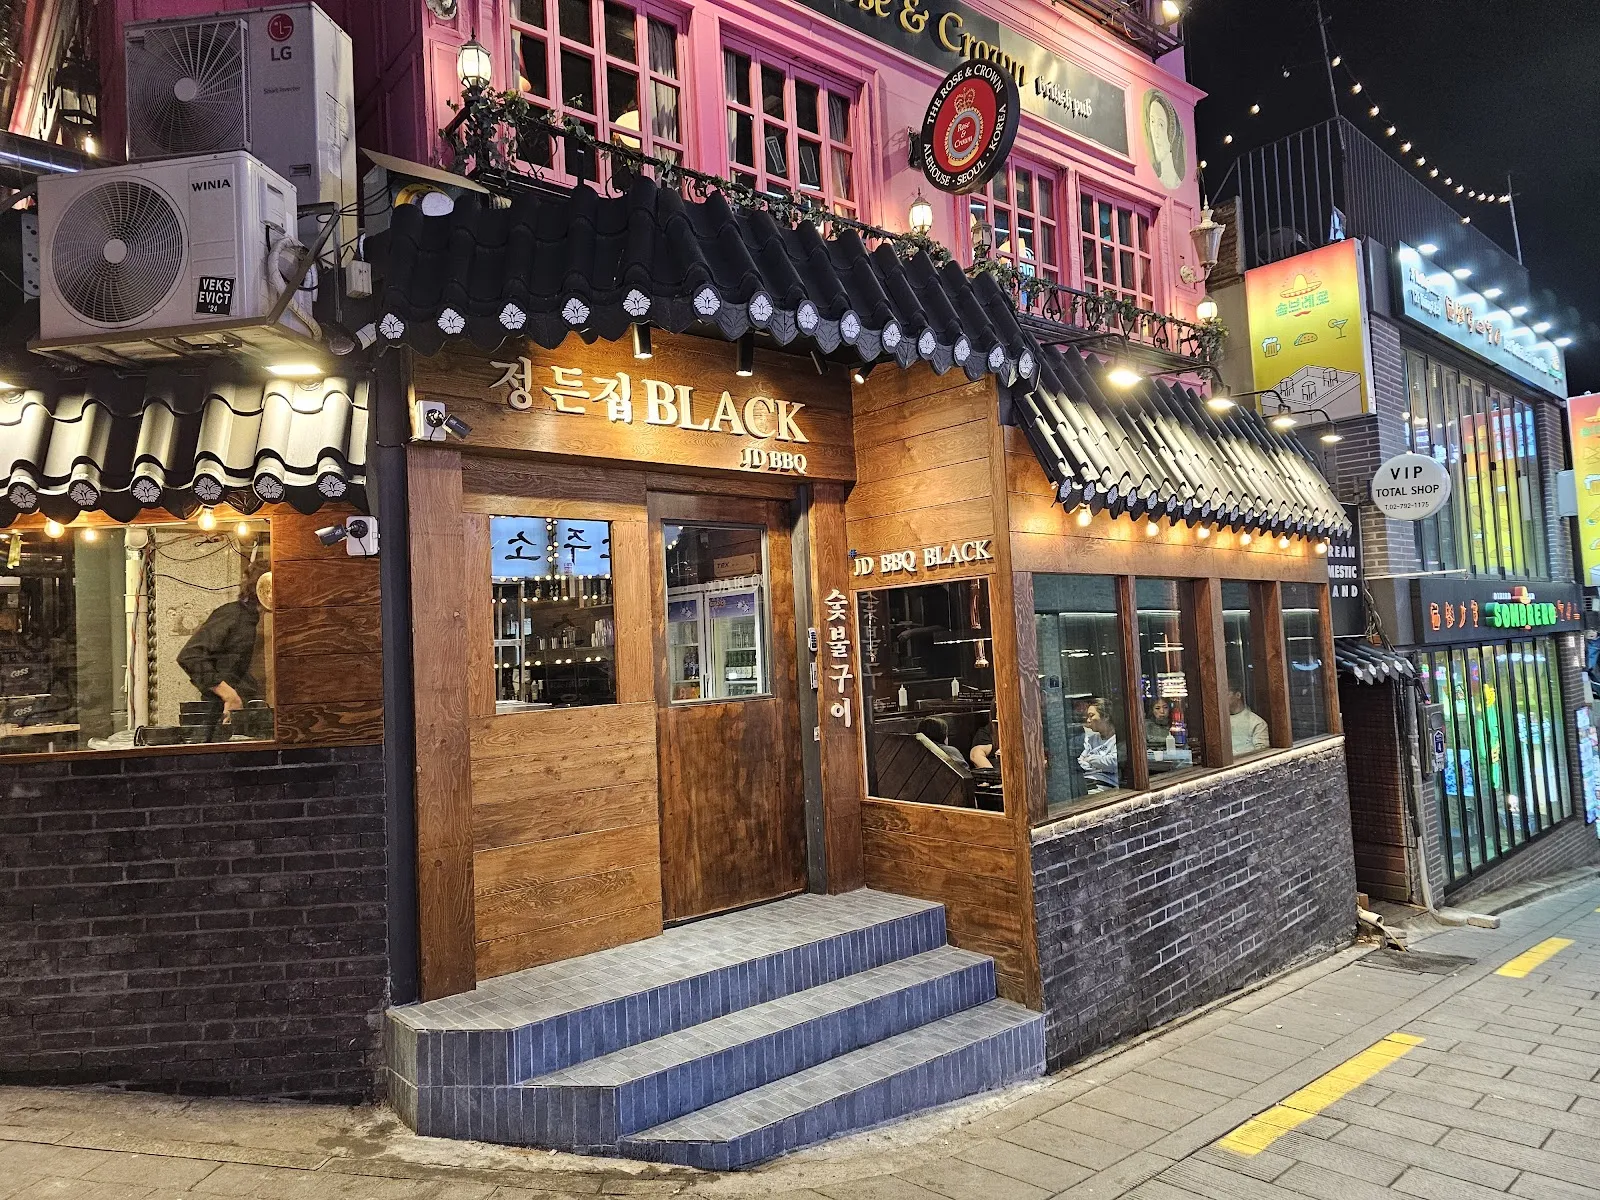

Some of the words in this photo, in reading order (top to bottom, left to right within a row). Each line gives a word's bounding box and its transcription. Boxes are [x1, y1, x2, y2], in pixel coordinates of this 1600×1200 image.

[900, 0, 930, 34] &
[270, 46, 292, 61] LG
[927, 98, 942, 125] THE
[940, 70, 964, 99] ROSE
[964, 66, 973, 77] &
[974, 64, 1004, 93] CROWN
[923, 143, 951, 186] ALEHOUSE
[956, 160, 986, 186] SEOUL
[988, 103, 1007, 151] KOREA
[191, 179, 231, 192] WINIA
[199, 291, 230, 305] EVICT
[202, 279, 231, 292] VEKS
[641, 379, 810, 443] BLACK
[740, 448, 766, 469] JD
[768, 451, 808, 475] BBQ
[1390, 466, 1423, 480] VIP
[1376, 487, 1407, 498] TOTAL
[1411, 484, 1440, 495] SHOP
[854, 557, 875, 576] JD
[879, 550, 917, 573] BBQ
[922, 539, 994, 568] BLACK
[1332, 585, 1359, 598] AND
[1493, 602, 1558, 628] SOMBRERO
[824, 588, 854, 728] 숯불구이
